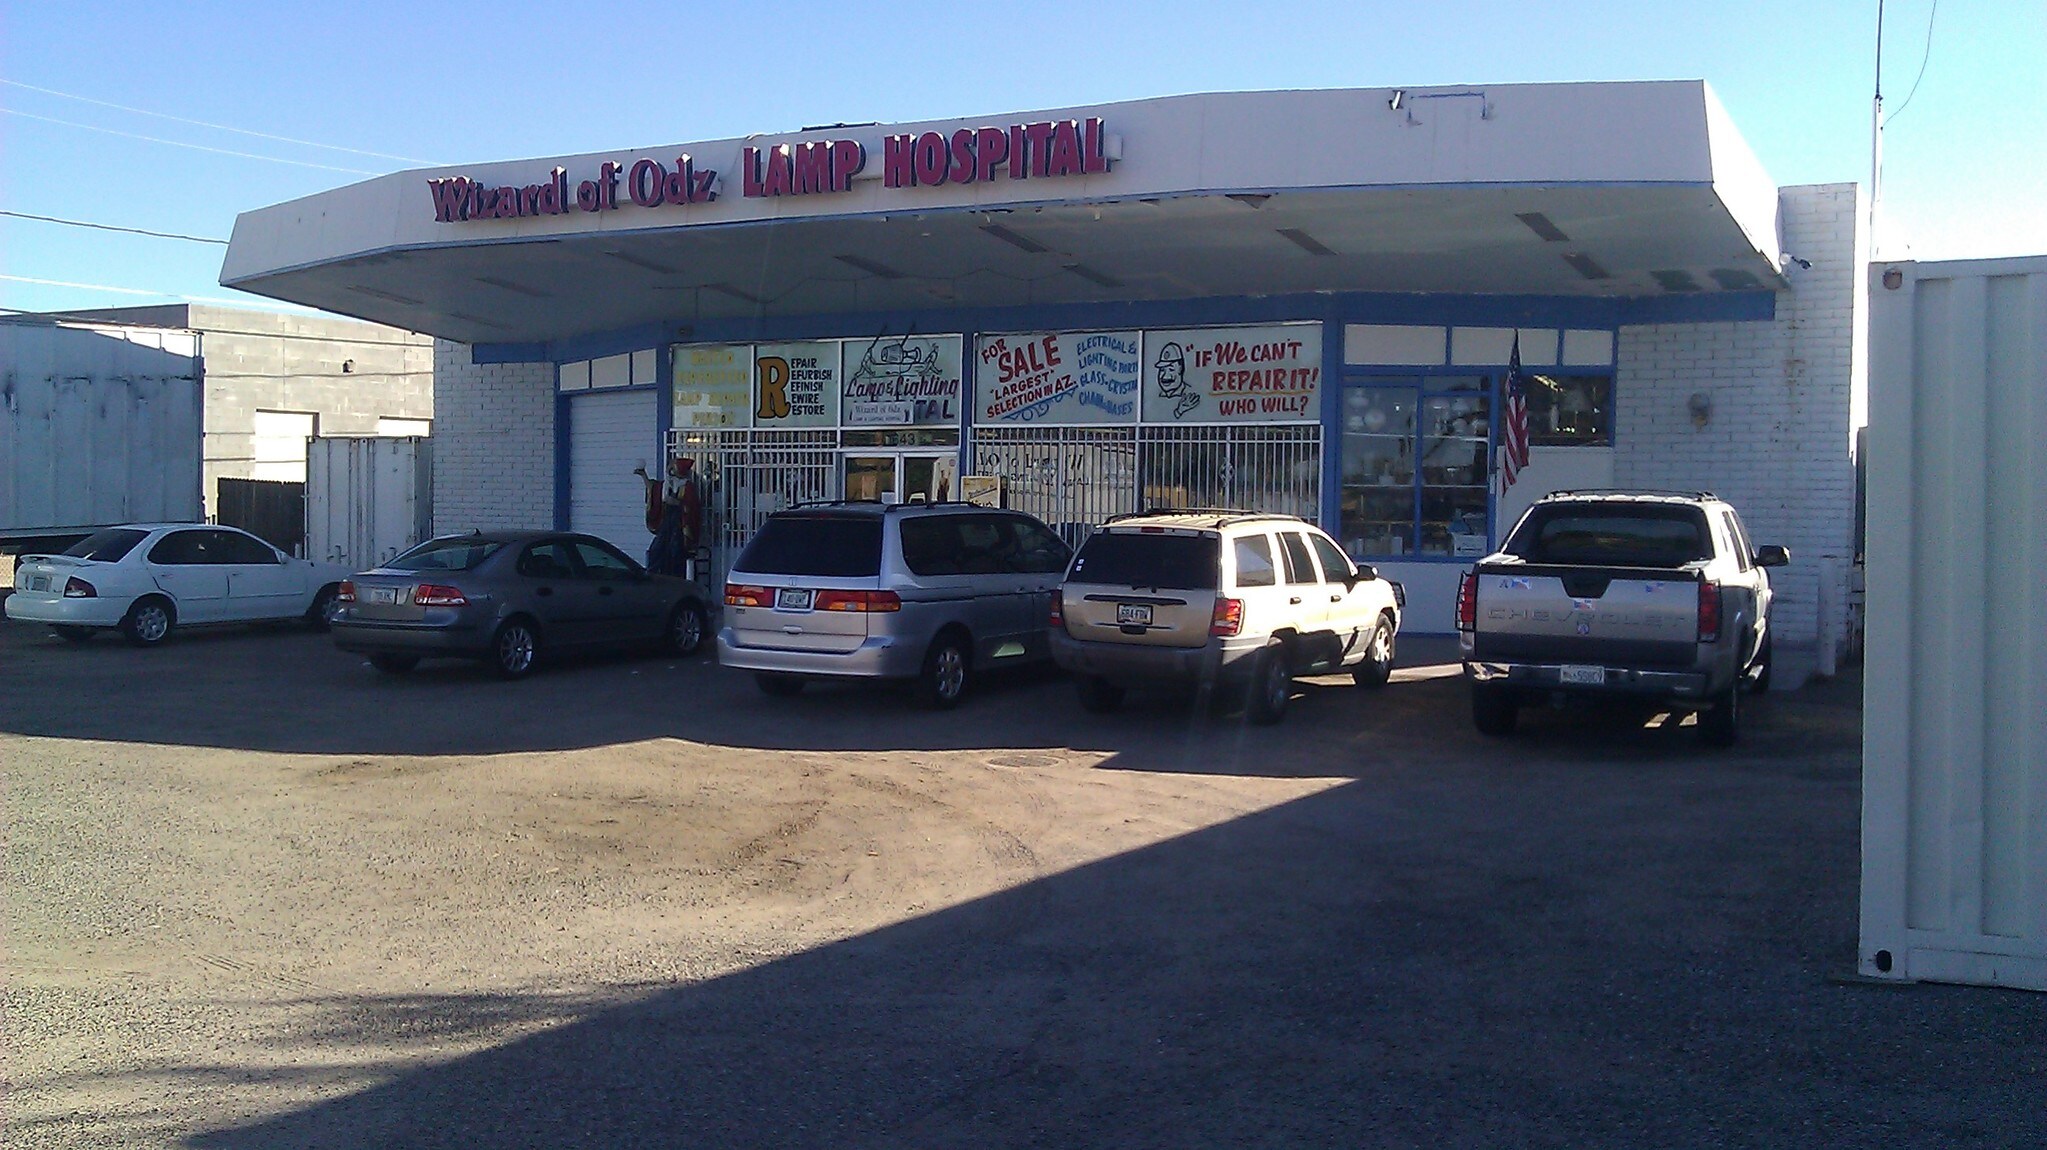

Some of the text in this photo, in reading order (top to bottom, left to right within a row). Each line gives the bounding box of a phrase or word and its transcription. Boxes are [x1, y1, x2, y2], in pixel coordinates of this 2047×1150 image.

[743, 116, 1111, 198] LAMP HOSPITAL
[427, 153, 718, 222] Wizard of Odz
[981, 338, 1007, 364] FOR
[1077, 335, 1137, 355] ELECTRICAL &
[1215, 341, 1248, 366] We
[1250, 339, 1303, 362] CAN'T
[791, 358, 817, 368] EPAIR
[998, 335, 1061, 383] SALE
[1078, 353, 1117, 372] LIGHTING
[791, 369, 833, 380] EFURBISH
[1212, 367, 1319, 391] REPAIR IT!
[757, 356, 791, 419] R
[791, 381, 824, 392] EFINISH
[845, 377, 885, 399] Lamp
[791, 393, 820, 404] EWIRE
[987, 387, 1043, 418] SELECTION
[1044, 383, 1054, 396] IN
[1220, 396, 1308, 416] WHO WILL?
[791, 405, 825, 416] ESTORE
[1488, 607, 1686, 629] CHEVROLET
